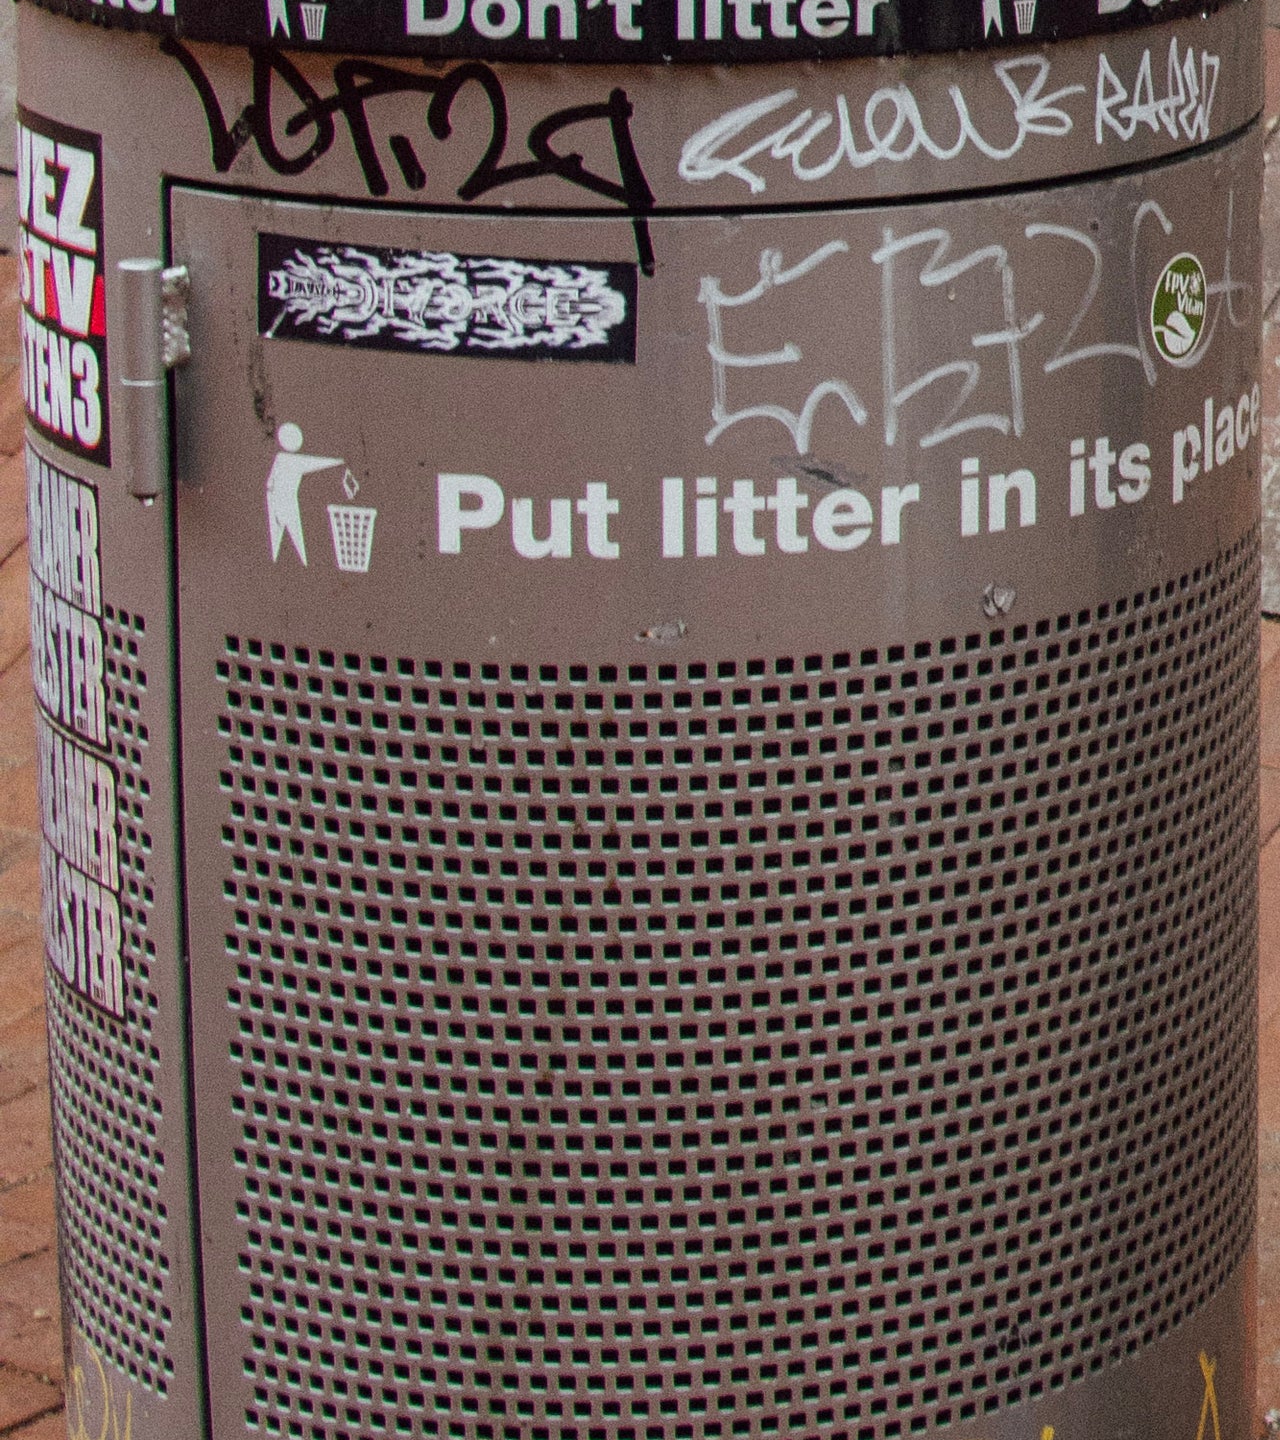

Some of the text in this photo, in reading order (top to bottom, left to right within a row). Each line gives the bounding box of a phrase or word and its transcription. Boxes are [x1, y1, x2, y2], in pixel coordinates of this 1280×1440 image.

[435, 385, 1261, 560] Put litter in its place
